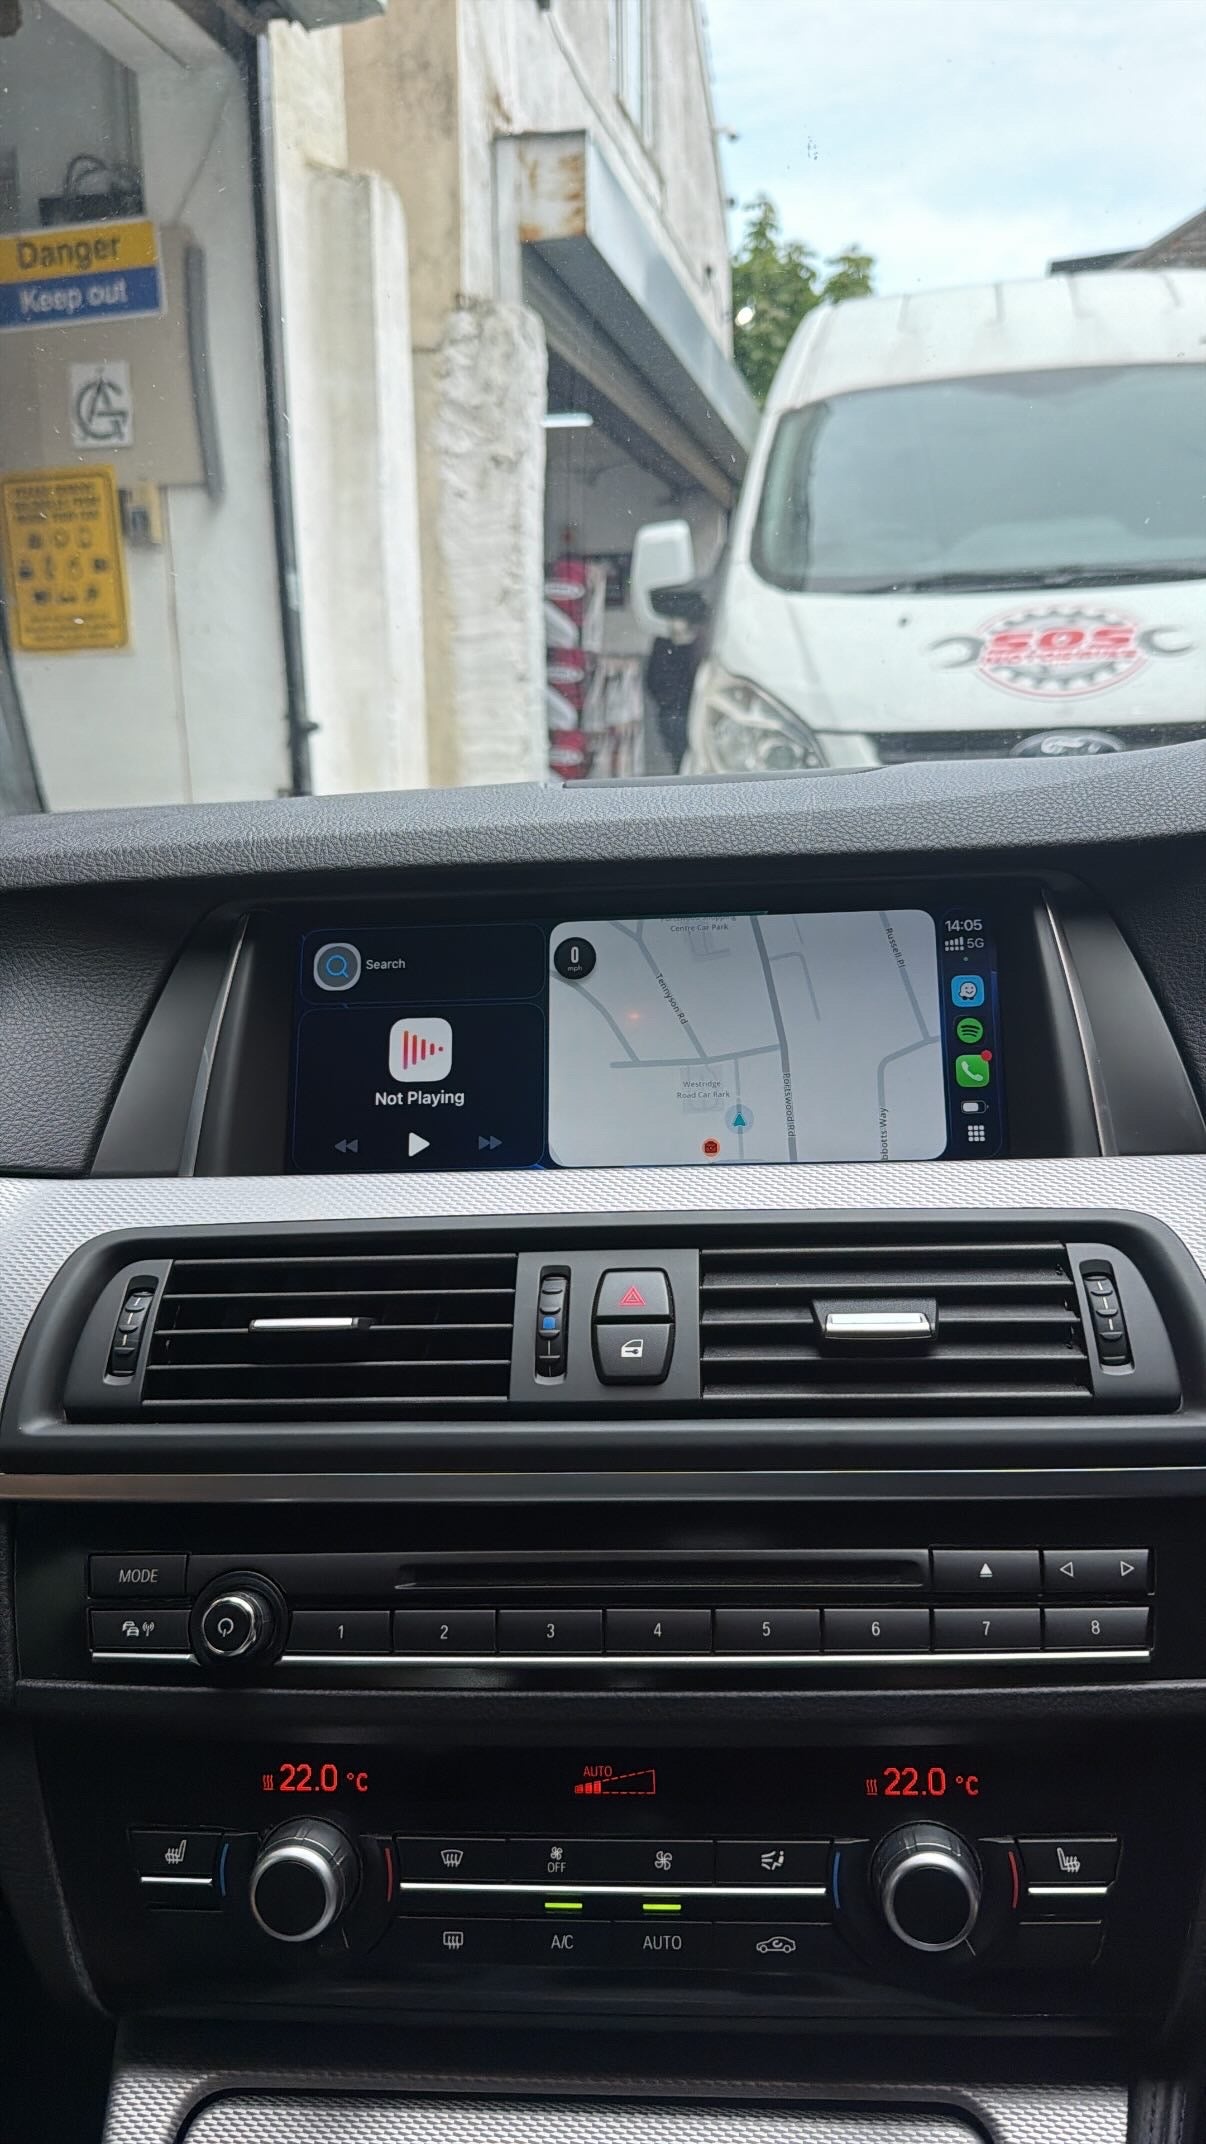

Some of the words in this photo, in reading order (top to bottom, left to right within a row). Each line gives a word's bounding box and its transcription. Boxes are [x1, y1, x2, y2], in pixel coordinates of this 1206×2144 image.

[16, 234, 121, 270] Danger
[18, 286, 82, 315] Keep
[87, 279, 128, 305] out
[992, 625, 1135, 650] SOS
[670, 924, 696, 932] Centre
[711, 923, 729, 931] Park
[945, 918, 983, 932] 14:05
[885, 927, 903, 958] Russell
[966, 937, 985, 949] 5G
[570, 946, 580, 964] 0
[365, 958, 406, 970] Search
[567, 965, 583, 973] mph
[656, 972, 680, 1013] Tennyson
[677, 1012, 689, 1025] Rd
[682, 1080, 721, 1089] Westridge
[375, 1091, 404, 1106] Not
[407, 1090, 465, 1107] Playing
[676, 1091, 697, 1099] Road
[698, 1091, 711, 1099] Car
[783, 1072, 795, 1122] Portswood
[879, 1107, 889, 1128] Way
[787, 1123, 797, 1137] Rd
[118, 1568, 159, 1584] MODE
[337, 1625, 344, 1640] 1
[440, 1624, 449, 1640] 2
[546, 1623, 555, 1638] 3
[653, 1622, 662, 1638] 4
[762, 1621, 771, 1637] 5
[871, 1621, 881, 1636] 6
[982, 1620, 991, 1635] 7
[1090, 1619, 1101, 1635] 8
[279, 1763, 338, 1792] 22.0
[583, 1765, 613, 1778] AUTO
[883, 1767, 946, 1796] 22.0
[546, 1861, 567, 1874] OFF
[551, 1933, 575, 1951] A/C
[643, 1935, 683, 1951] AUTO
